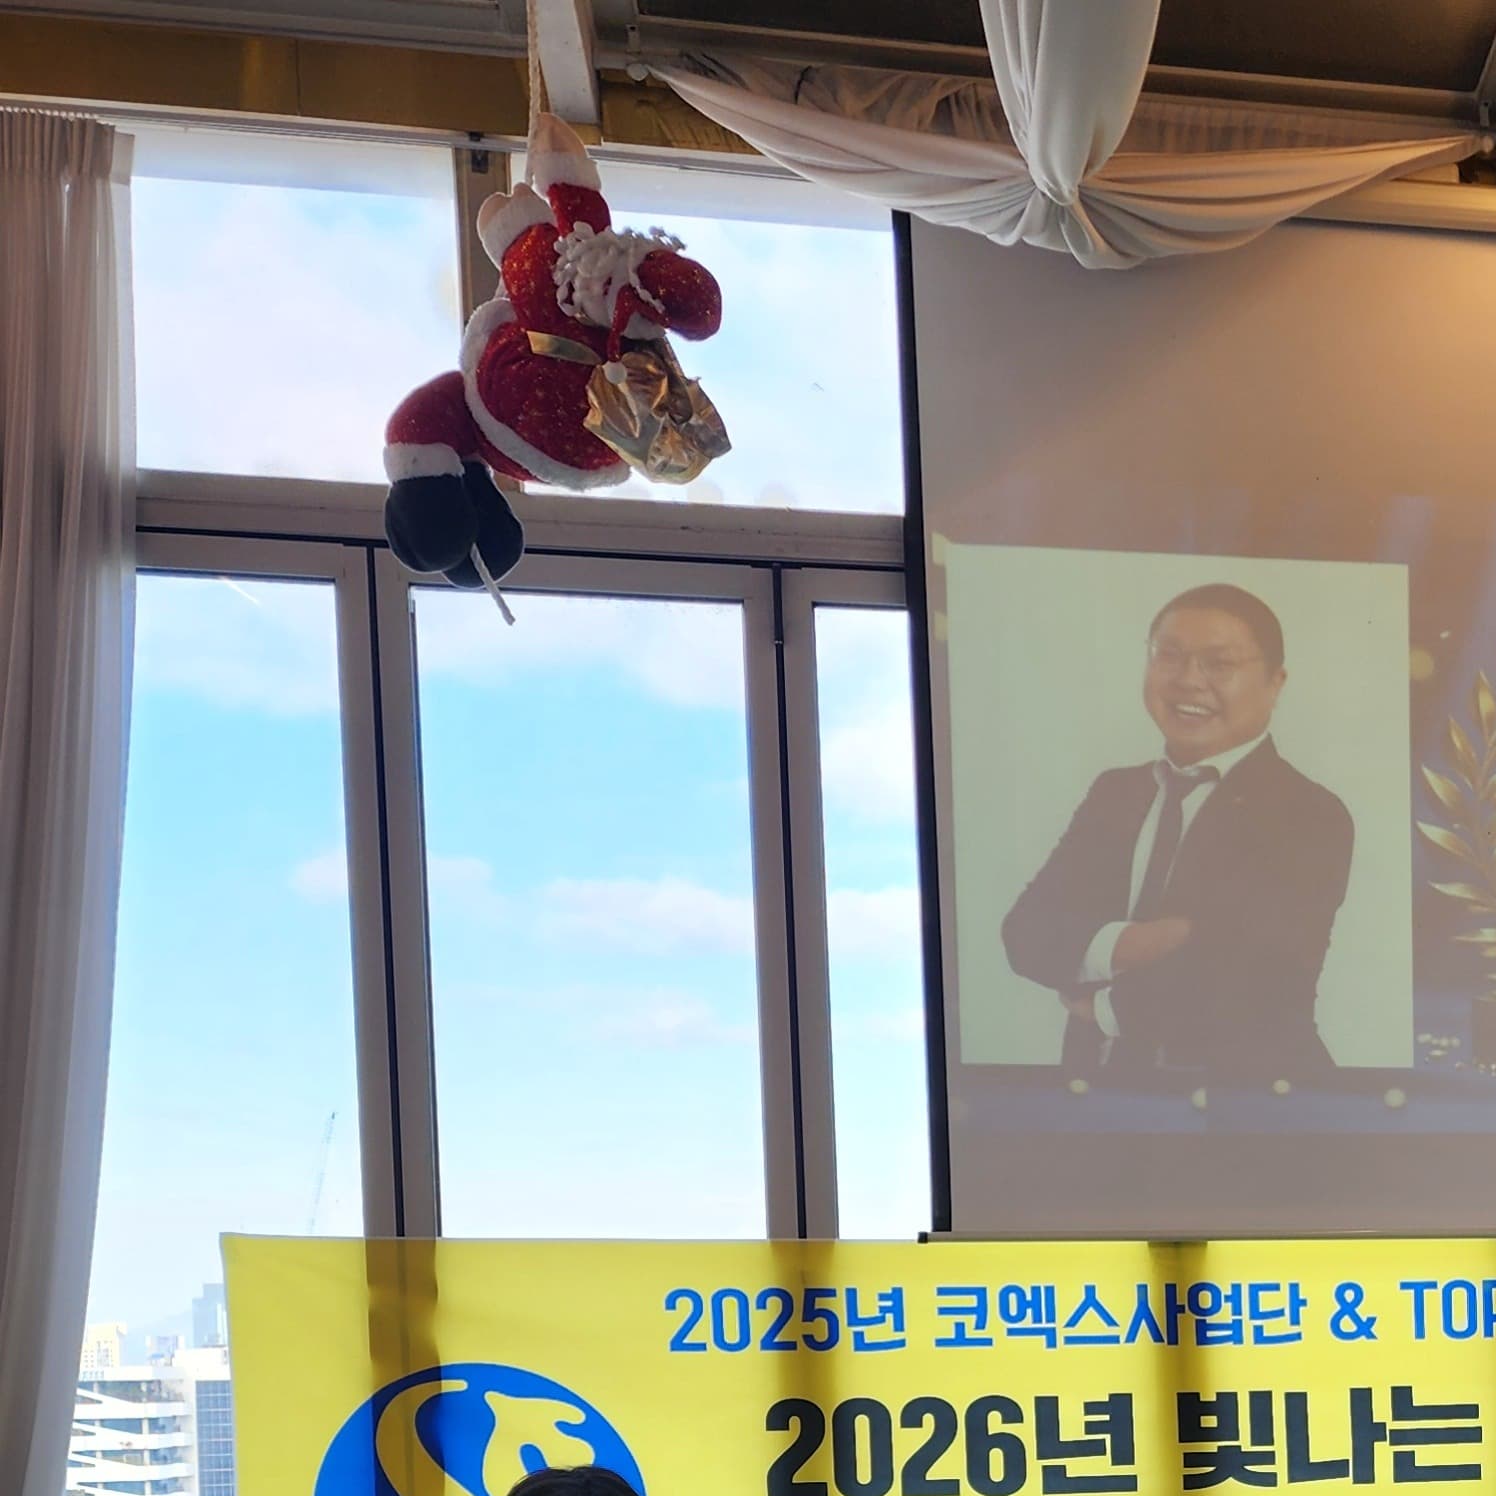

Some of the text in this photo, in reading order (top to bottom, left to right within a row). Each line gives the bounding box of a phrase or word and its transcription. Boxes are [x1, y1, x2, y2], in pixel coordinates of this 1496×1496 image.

[664, 1286, 907, 1353] 2025년
[934, 1282, 1308, 1349] 코엑스사업단
[1330, 1281, 1377, 1341] &
[1176, 1386, 1483, 1491] 빛나는
